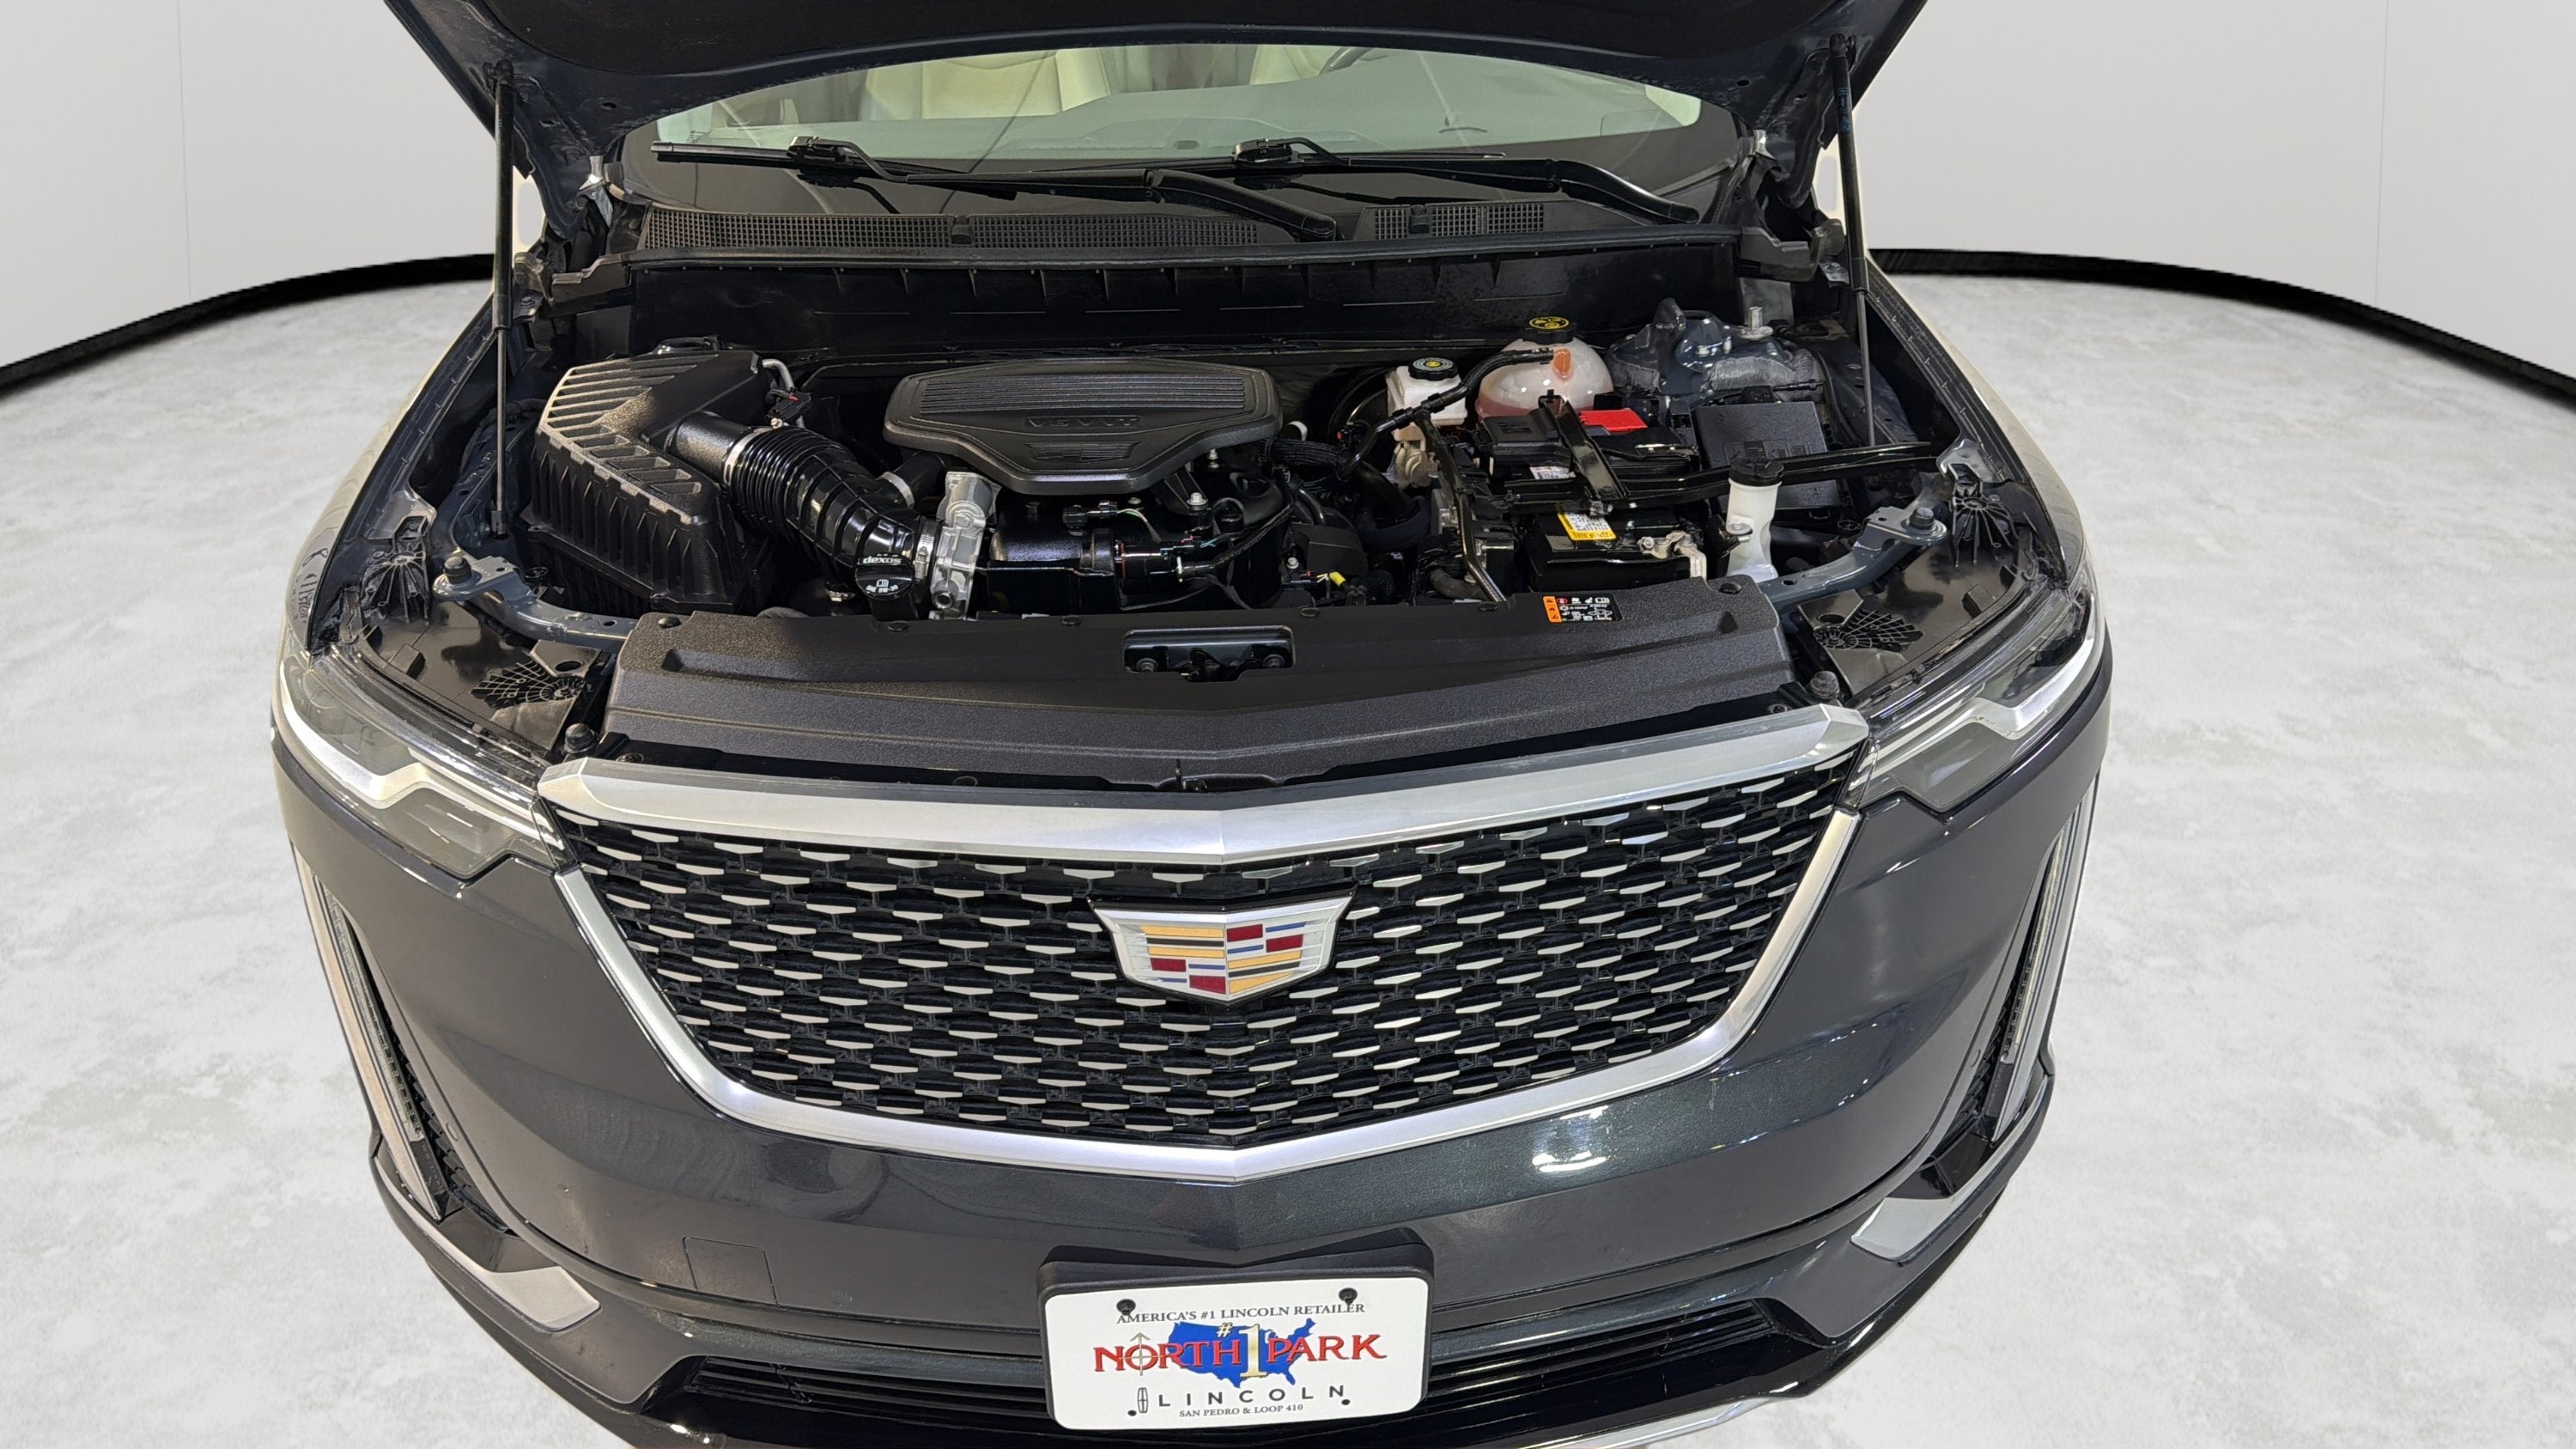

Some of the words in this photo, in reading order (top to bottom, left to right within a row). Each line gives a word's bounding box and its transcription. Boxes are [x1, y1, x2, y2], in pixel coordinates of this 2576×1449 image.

[862, 556, 902, 565] dexos
[1116, 1311, 1197, 1324] AMERICA'S
[1200, 1310, 1216, 1319] #1
[1220, 1306, 1290, 1319] LINCOLN
[1294, 1303, 1365, 1315] RETAILER
[1092, 1338, 1242, 1373] NORTH
[1267, 1333, 1388, 1364] PARK
[1158, 1385, 1345, 1408] LINCOLN
[1179, 1409, 1201, 1418] SAN
[1203, 1406, 1240, 1416] PEDRO
[1242, 1406, 1252, 1415] &
[1255, 1404, 1284, 1414] LOOP
[1285, 1403, 1304, 1413] 410
